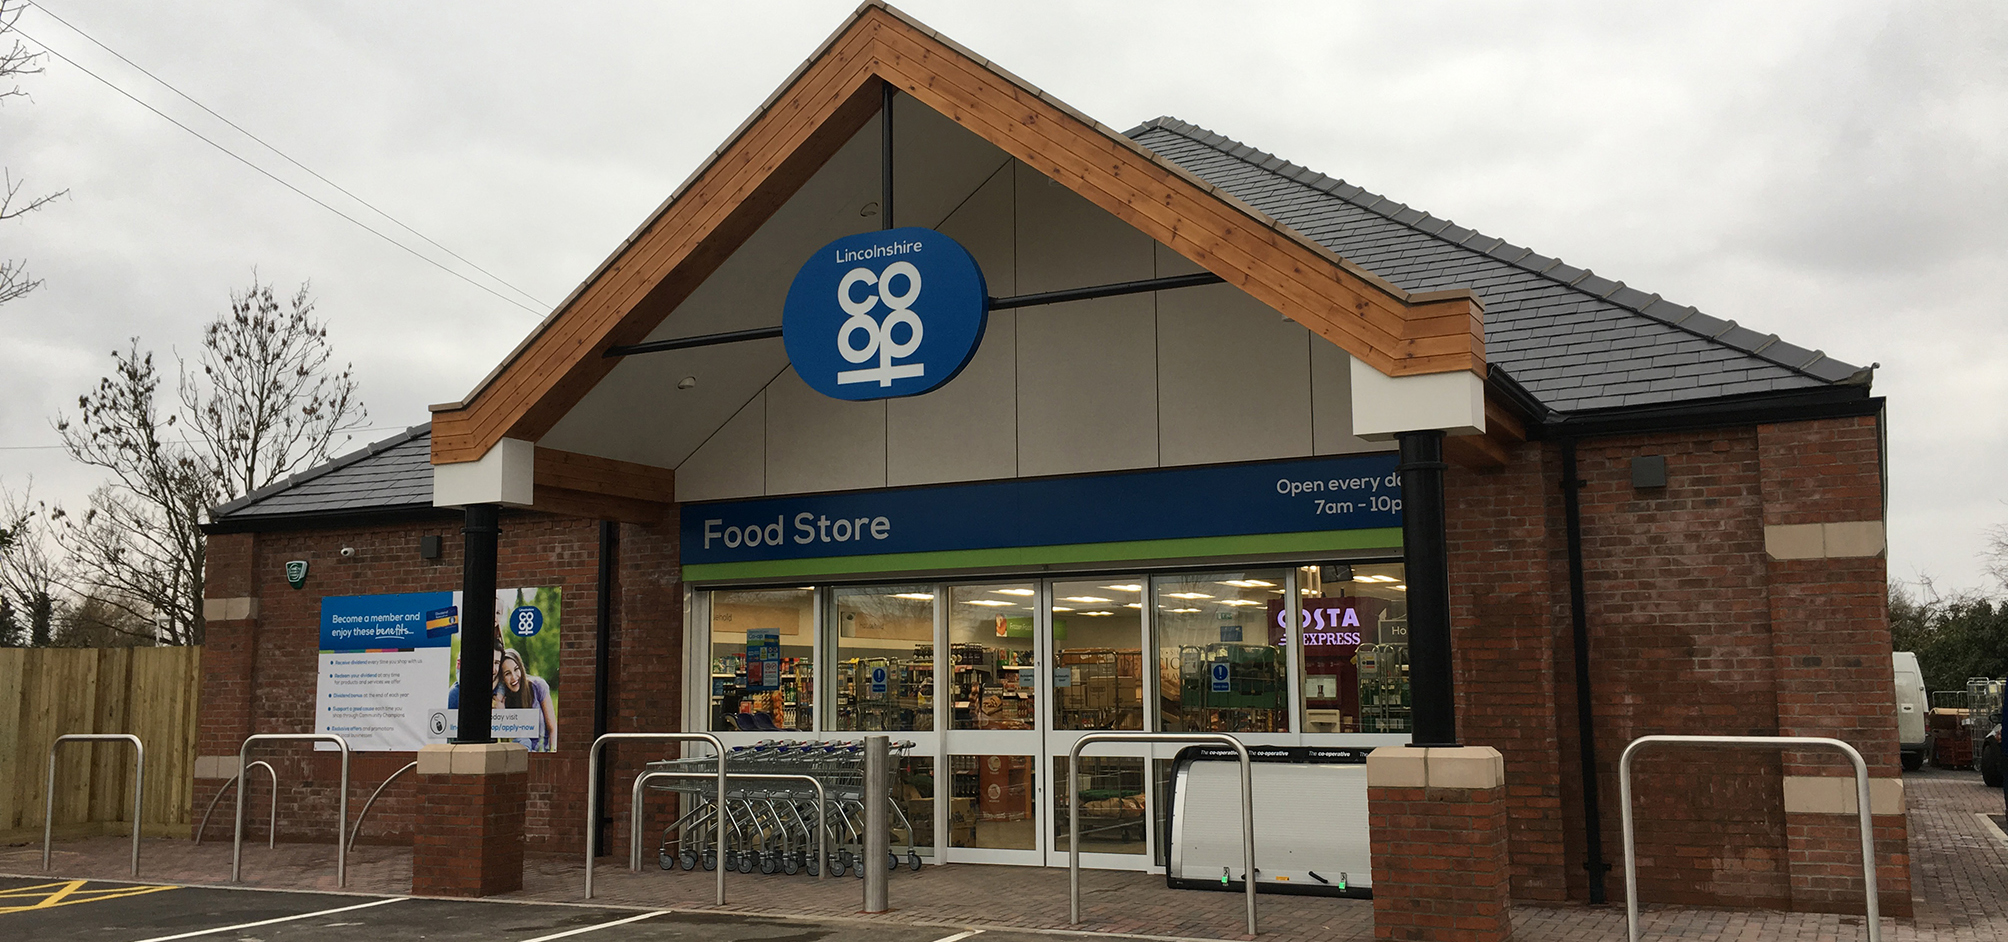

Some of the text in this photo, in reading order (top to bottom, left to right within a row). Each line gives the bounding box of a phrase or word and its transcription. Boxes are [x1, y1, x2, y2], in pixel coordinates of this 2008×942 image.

[836, 240, 922, 263] Lincolnshire
[1276, 479, 1324, 497] Open
[1328, 476, 1380, 492] every
[1314, 500, 1353, 514] 7am
[704, 512, 890, 549] Food Store
[332, 612, 420, 624] Become a member and
[331, 628, 351, 639] enjoy
[353, 627, 374, 636] these
[1303, 632, 1360, 645] EXPRESS
